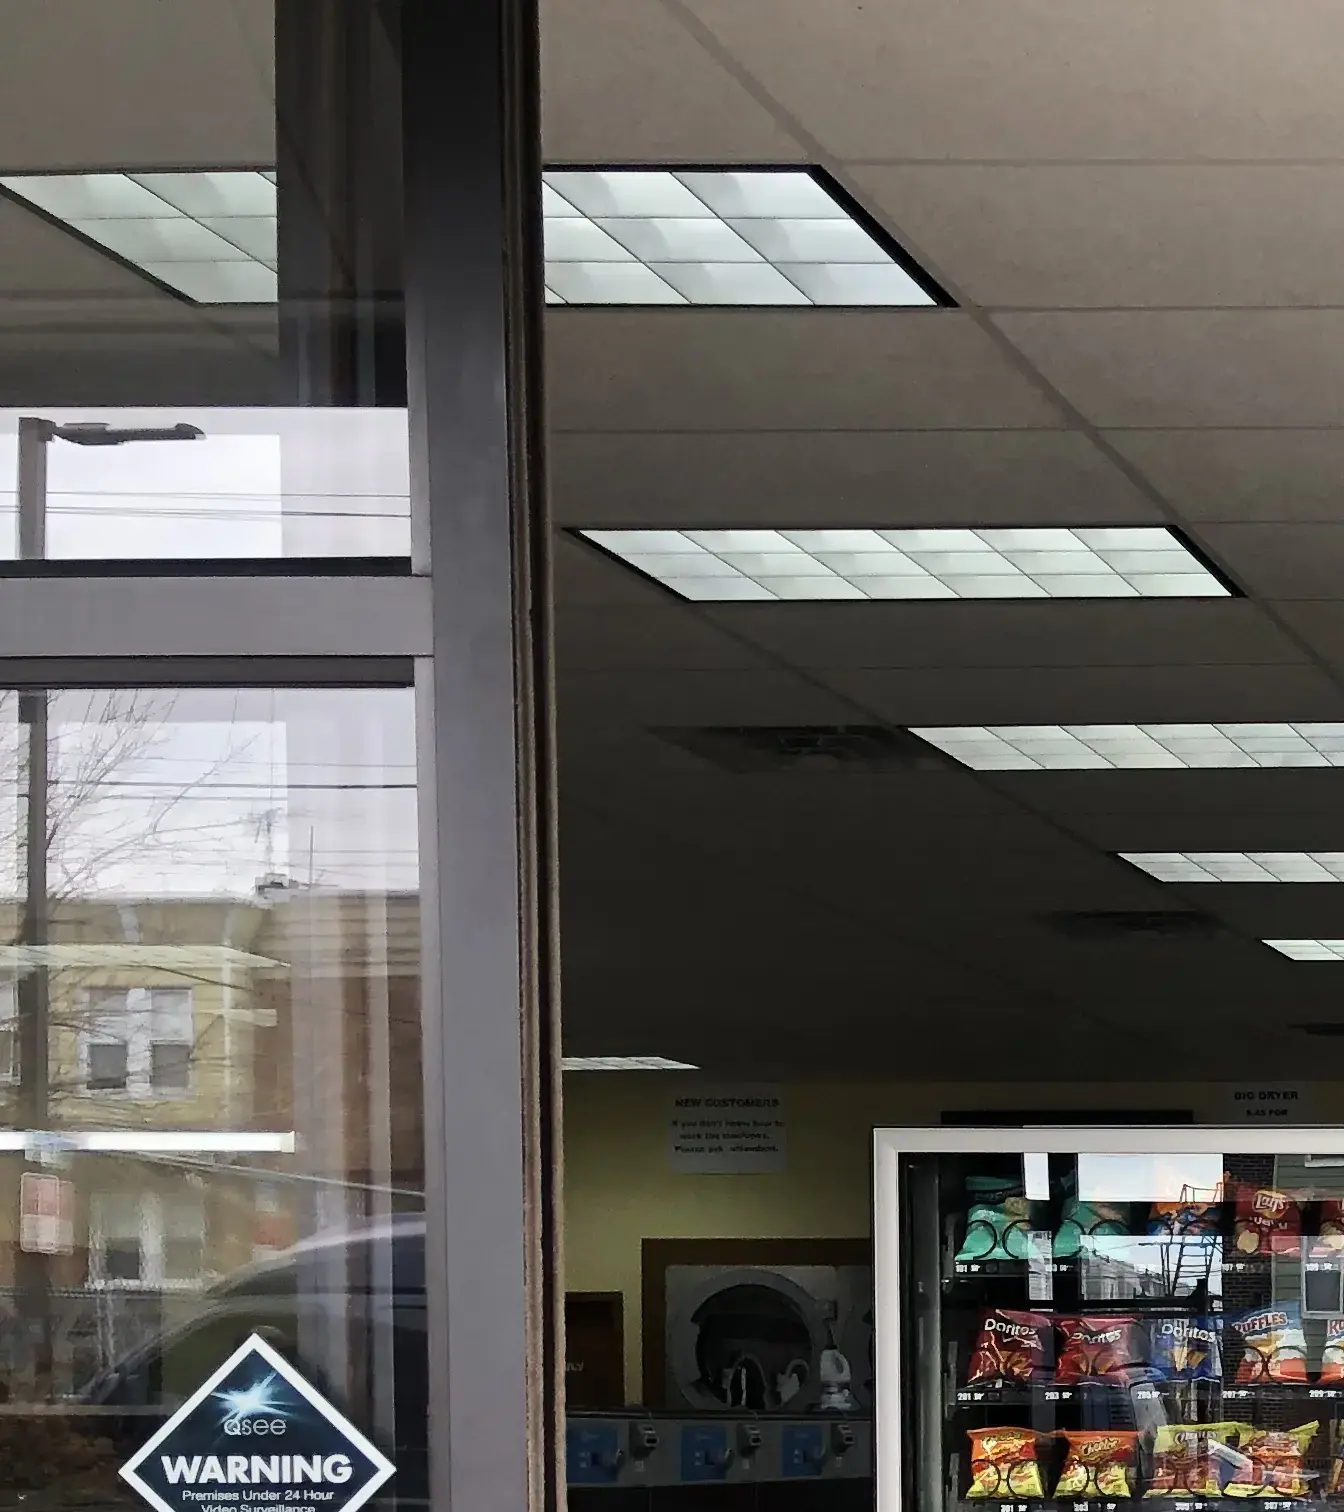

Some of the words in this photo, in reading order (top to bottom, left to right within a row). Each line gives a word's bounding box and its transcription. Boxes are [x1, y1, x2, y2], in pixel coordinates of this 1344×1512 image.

[674, 1097, 702, 1107] NEW
[705, 1097, 780, 1107] CUSTOMERS
[1258, 1091, 1299, 1100] DRYER
[984, 1317, 1037, 1337] Doritos
[1233, 1311, 1288, 1333] RUFFLES
[1161, 1322, 1216, 1343] Doritos
[161, 1455, 353, 1484] WARNING
[181, 1489, 239, 1503] Premises
[242, 1489, 282, 1502] Under
[285, 1489, 300, 1502] 24
[304, 1489, 334, 1502] Hour
